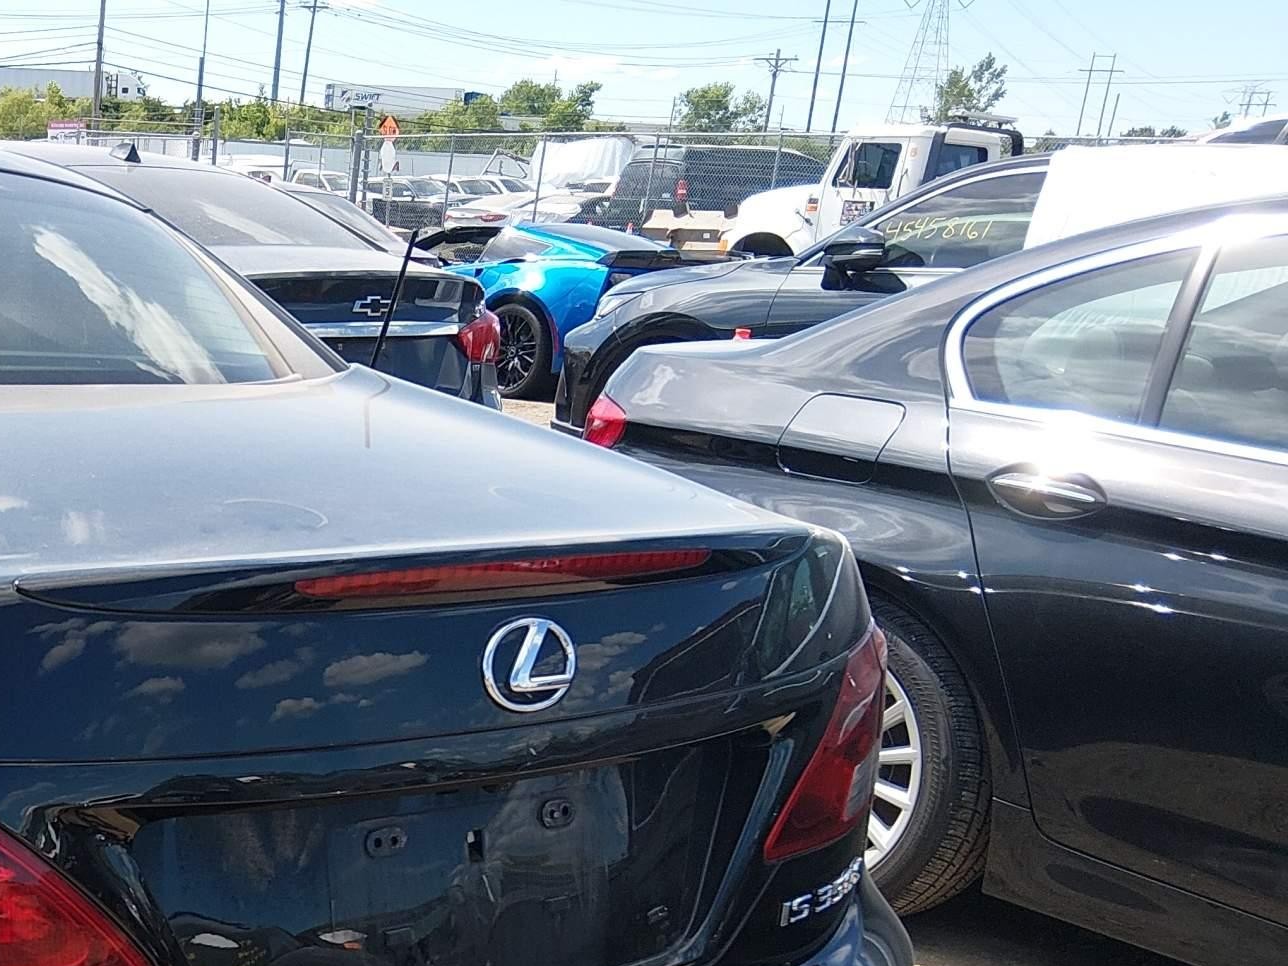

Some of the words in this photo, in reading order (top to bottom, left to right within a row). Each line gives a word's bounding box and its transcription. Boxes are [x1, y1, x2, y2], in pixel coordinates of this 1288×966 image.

[354, 92, 382, 101] SWIFT
[886, 216, 993, 241] 45458161
[780, 894, 812, 927] IS
